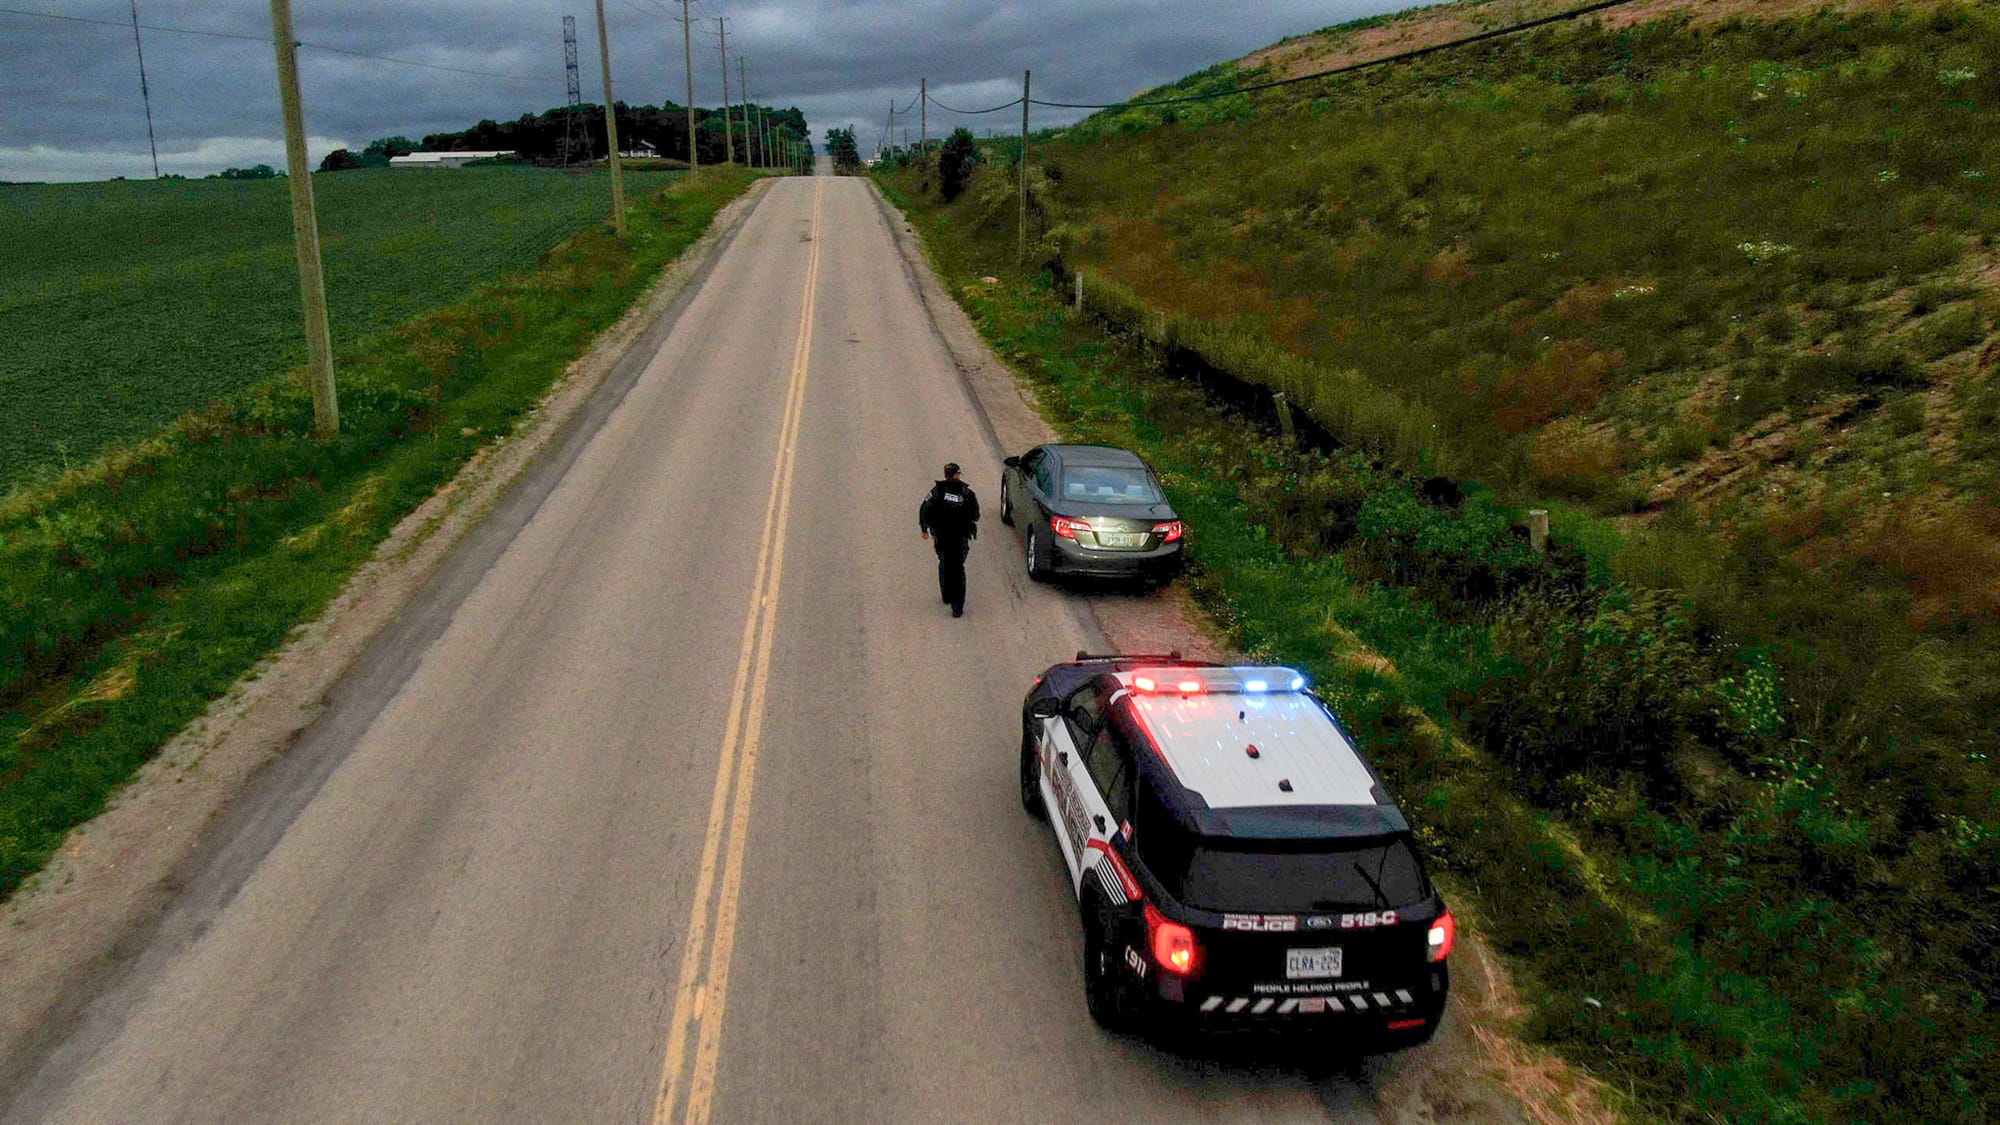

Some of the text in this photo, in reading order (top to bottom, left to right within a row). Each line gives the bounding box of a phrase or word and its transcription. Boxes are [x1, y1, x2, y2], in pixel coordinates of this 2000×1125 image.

[1223, 920, 1297, 932] POLICE
[1341, 910, 1396, 929] 518-C
[1253, 980, 1370, 993] PEOPLE HELPING PEOPLE
